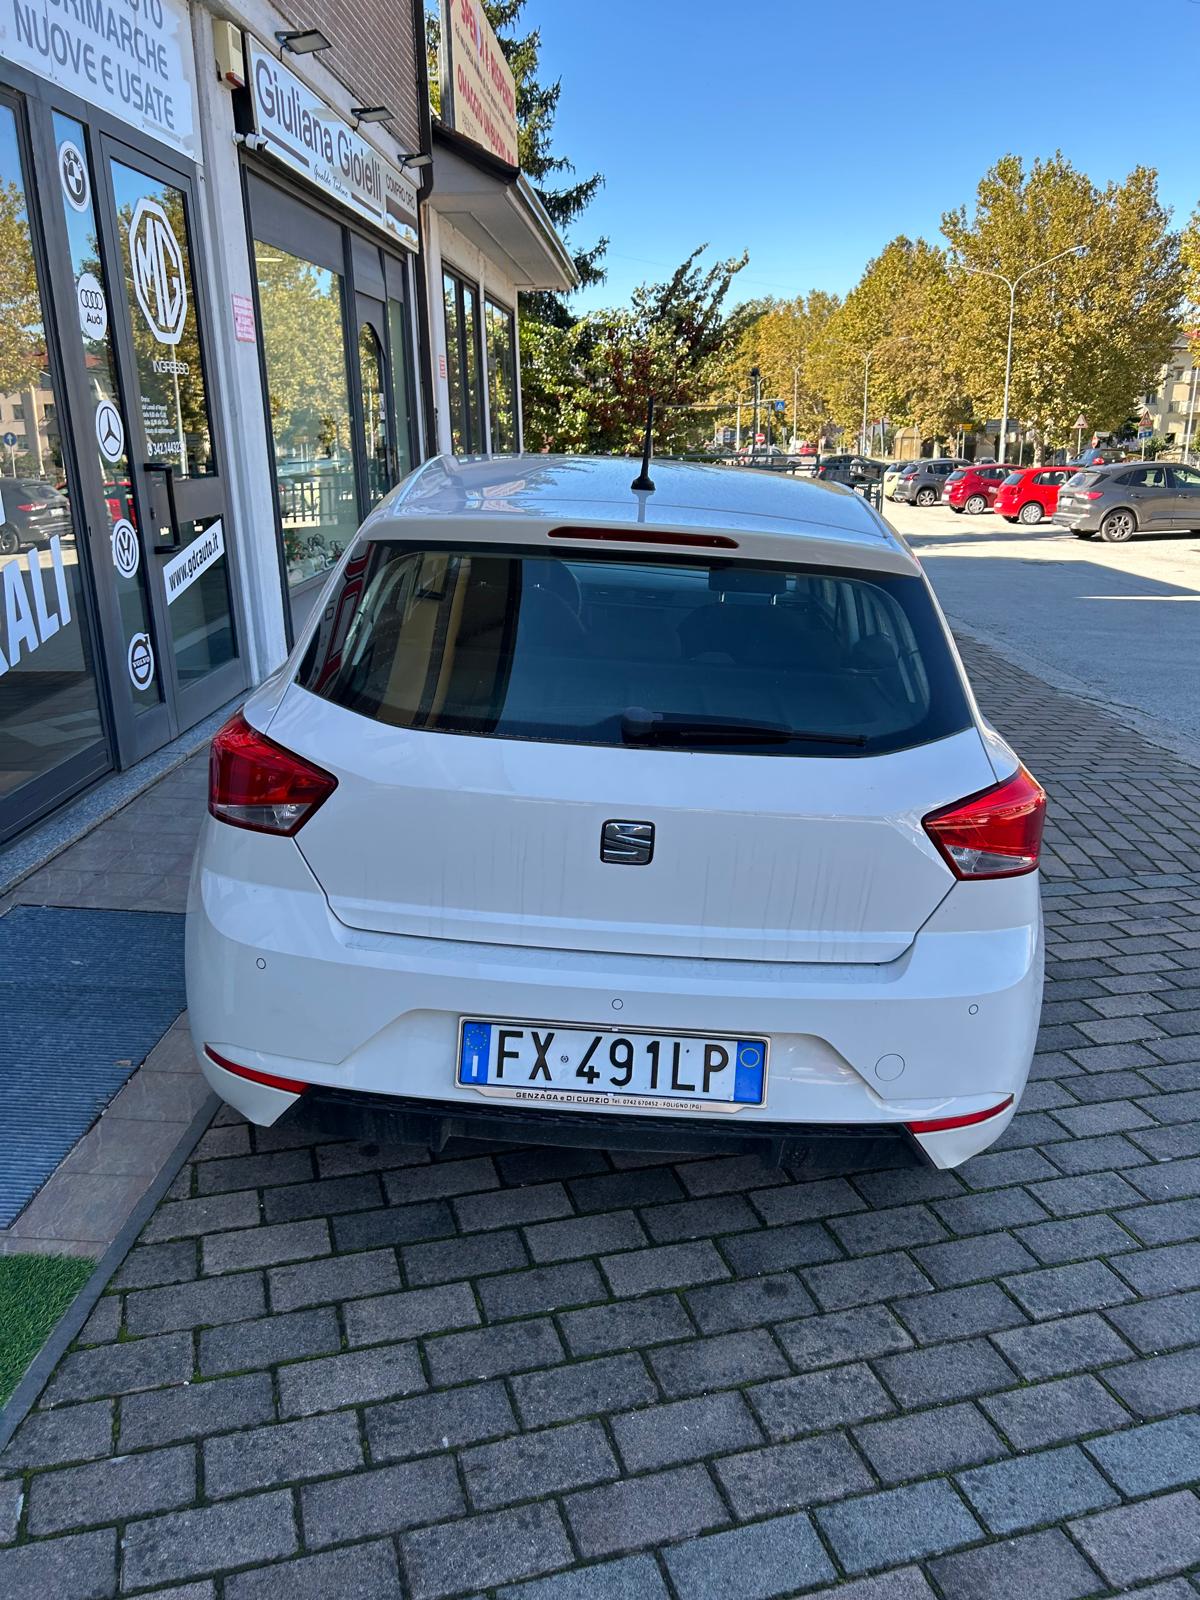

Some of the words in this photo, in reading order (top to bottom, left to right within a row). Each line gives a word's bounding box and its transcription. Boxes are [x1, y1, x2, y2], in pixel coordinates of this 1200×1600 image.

[13, 0, 97, 85] NUOVE
[101, 55, 114, 95] E
[117, 62, 175, 130] USATE
[51, 0, 168, 80] IMARCHE
[255, 58, 333, 166] Giuliana
[337, 130, 382, 203] Gioielli
[386, 174, 405, 202] COMPRO
[136, 217, 179, 328] MG
[86, 312, 103, 325] Audi
[153, 361, 189, 375] INGRESSO
[169, 532, 219, 592] www.gdcauto.it
[0, 534, 71, 677] ALI
[496, 1030, 555, 1081] FX
[576, 1036, 729, 1093] 491LP
[577, 1096, 610, 1104] CURZIO
